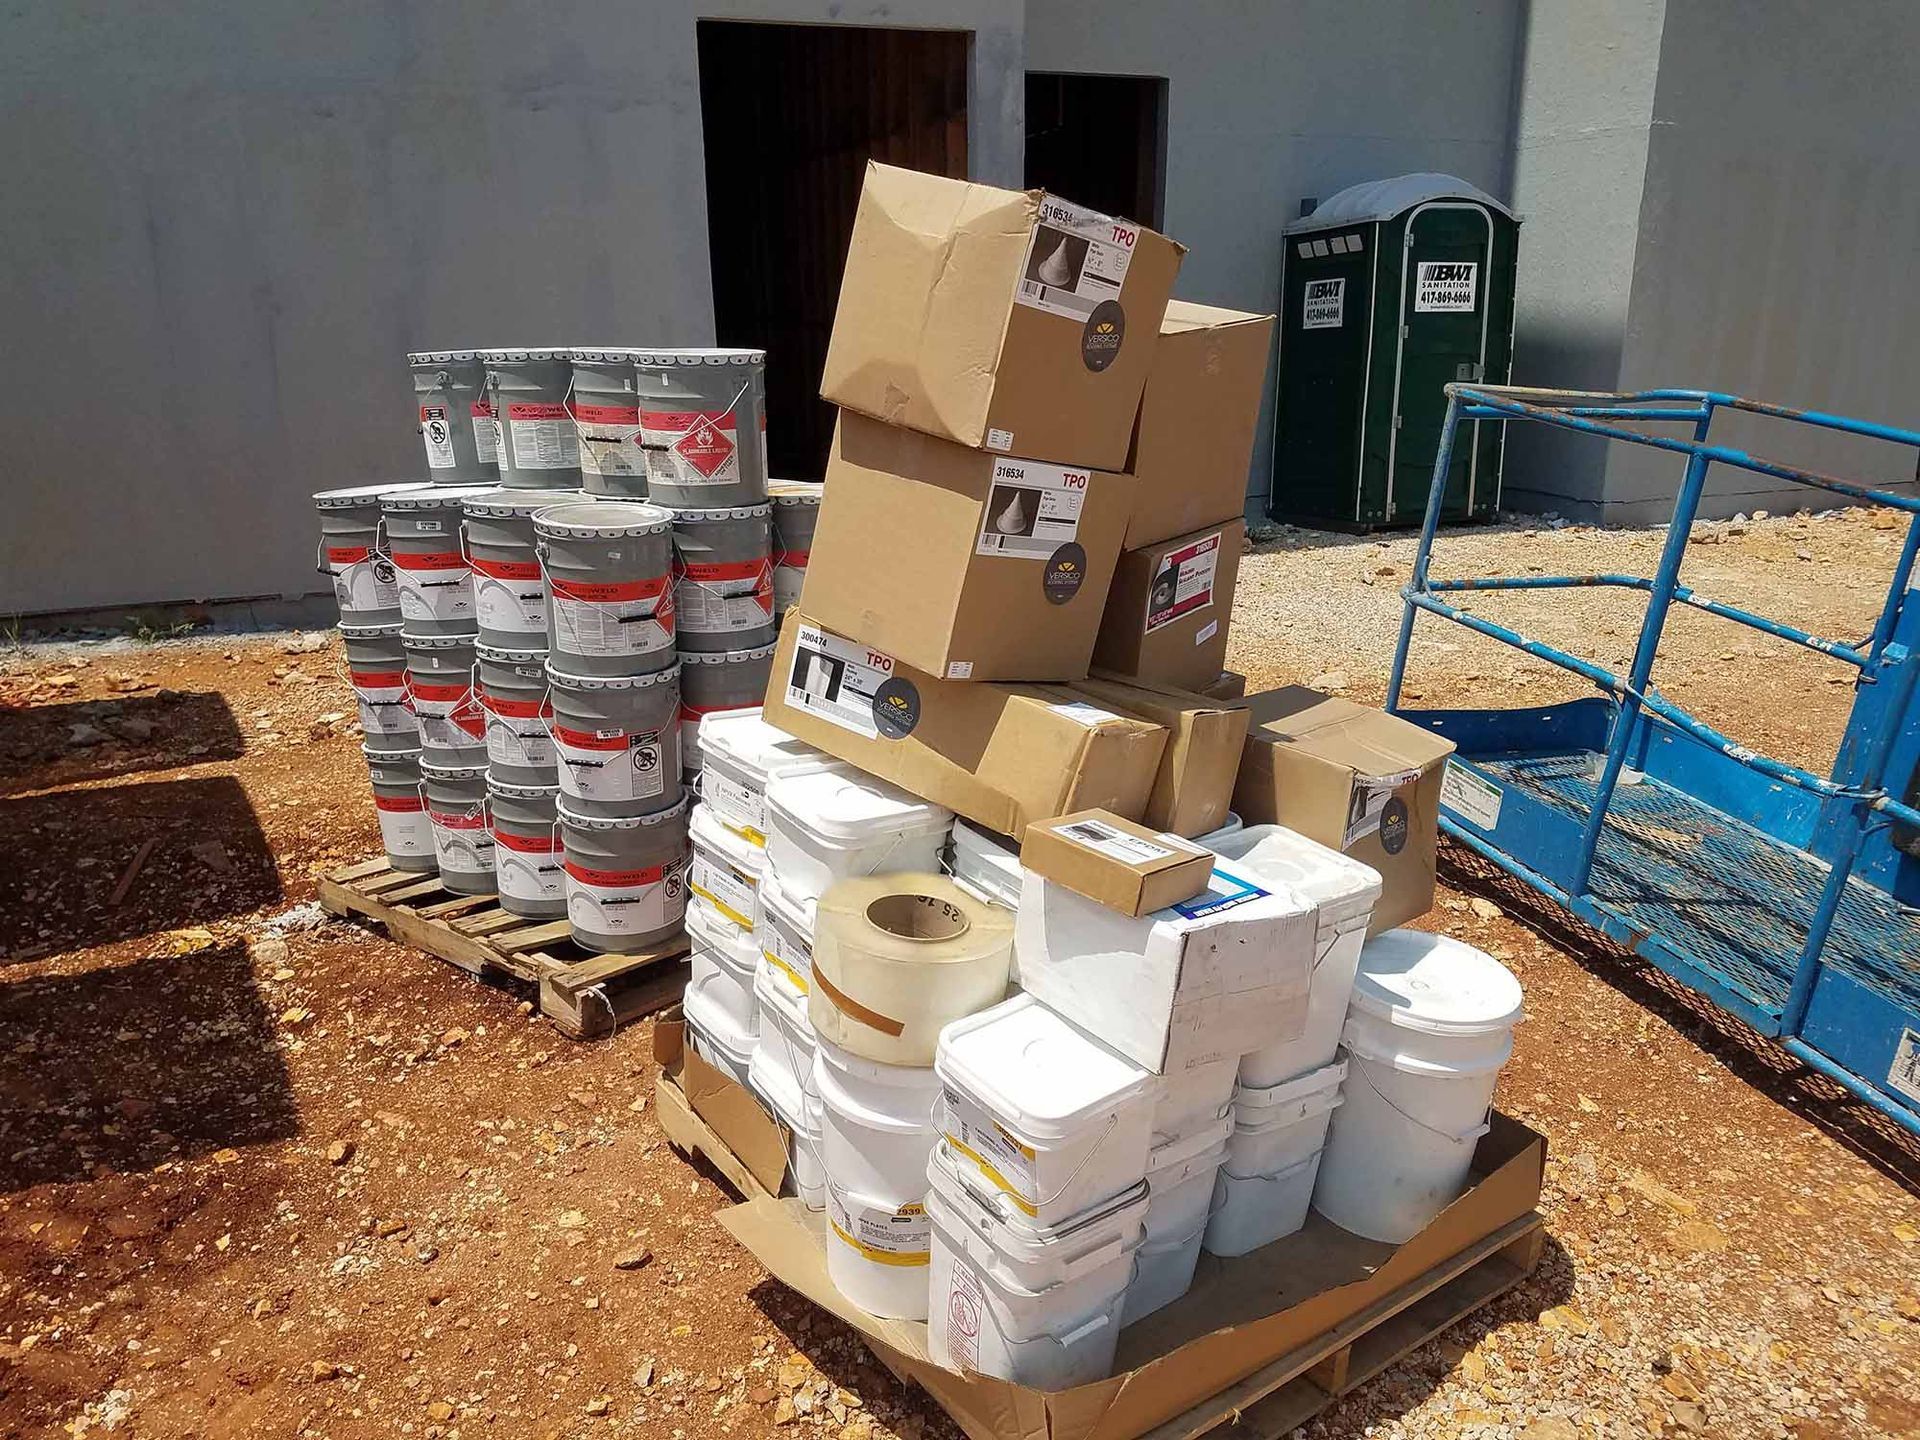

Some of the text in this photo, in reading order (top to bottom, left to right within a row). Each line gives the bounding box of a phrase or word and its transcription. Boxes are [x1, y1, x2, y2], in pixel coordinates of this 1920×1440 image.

[1111, 225, 1136, 248] TPO
[1432, 264, 1473, 281] BWI
[1421, 281, 1470, 289] SANITATION
[1307, 298, 1339, 306] SANITATION
[1420, 291, 1472, 304] 417-869-6666
[996, 466, 1025, 479] 316534
[1063, 473, 1086, 489] TPO
[1049, 571, 1080, 580] VERSICO
[800, 631, 828, 648] 300474
[866, 651, 892, 672] TPO
[879, 700, 914, 723] VERSICO
